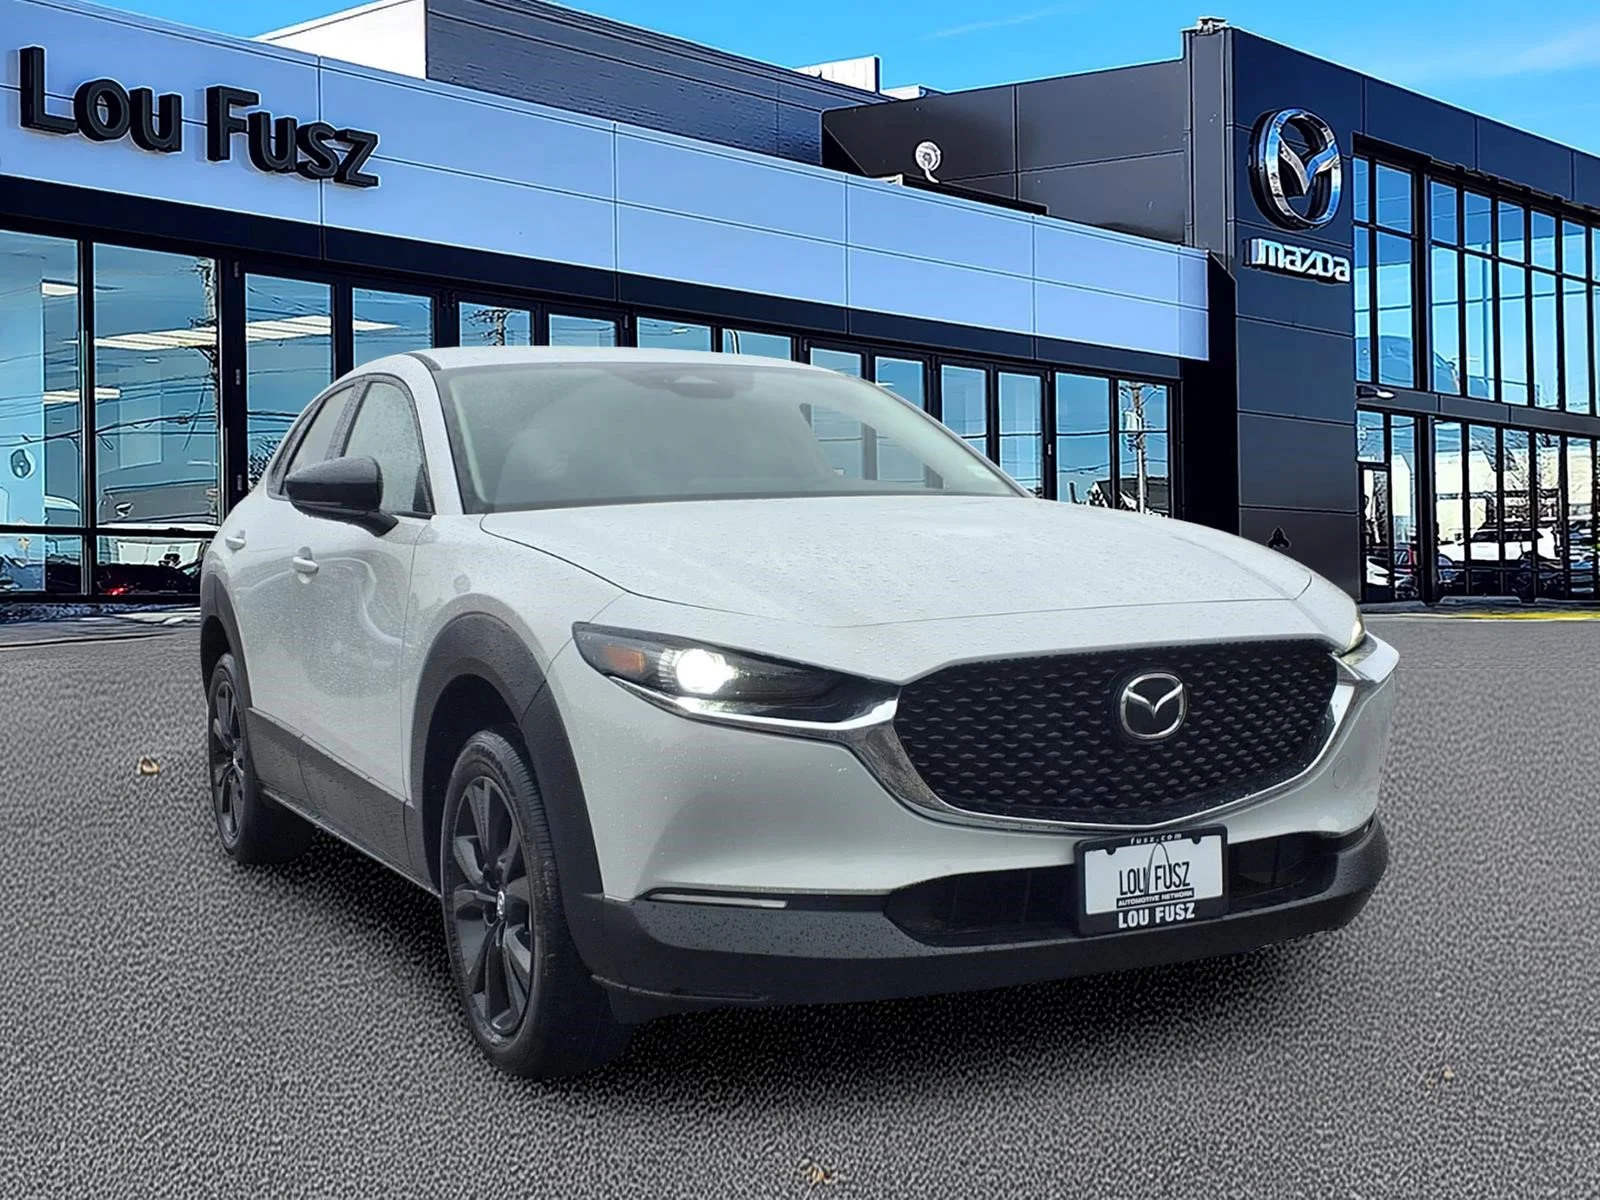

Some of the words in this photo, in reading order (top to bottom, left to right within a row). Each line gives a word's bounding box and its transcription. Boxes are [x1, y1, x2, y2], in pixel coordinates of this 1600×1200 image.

[18, 45, 183, 154] Lou
[206, 84, 380, 189] Fusz
[1119, 866, 1147, 896] LOU
[1155, 861, 1190, 891] FUSZ
[1118, 894, 1160, 906] AUTOMOTIVE
[1161, 890, 1193, 900] NETWORK
[1118, 908, 1149, 928] LOU
[1155, 902, 1195, 923] FUSZ
